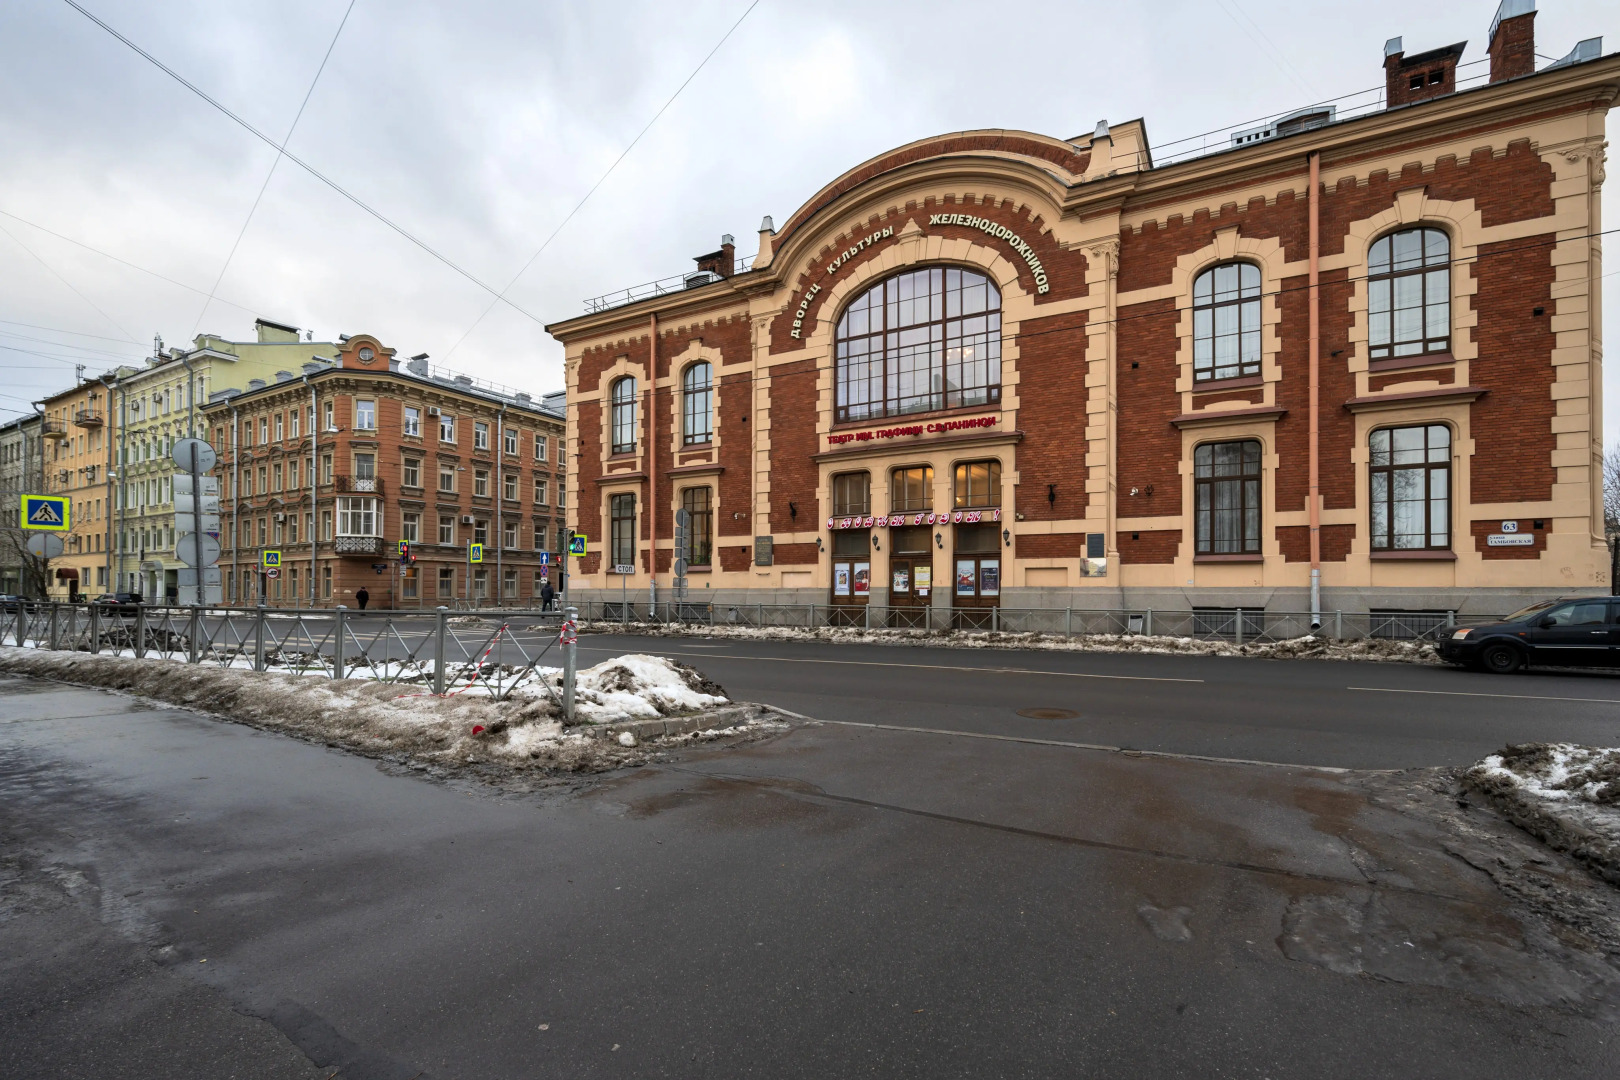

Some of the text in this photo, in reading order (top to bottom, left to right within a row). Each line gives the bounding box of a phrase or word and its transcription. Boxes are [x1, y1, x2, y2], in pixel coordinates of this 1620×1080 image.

[790, 212, 1050, 339] ДВОРЕЦ КУЛЬТУРЫ ЖЕЛЕЗНОДОРОЖНИКОВ
[827, 434, 854, 444] ТЕАТР
[876, 425, 923, 438] ГРАФИНИ
